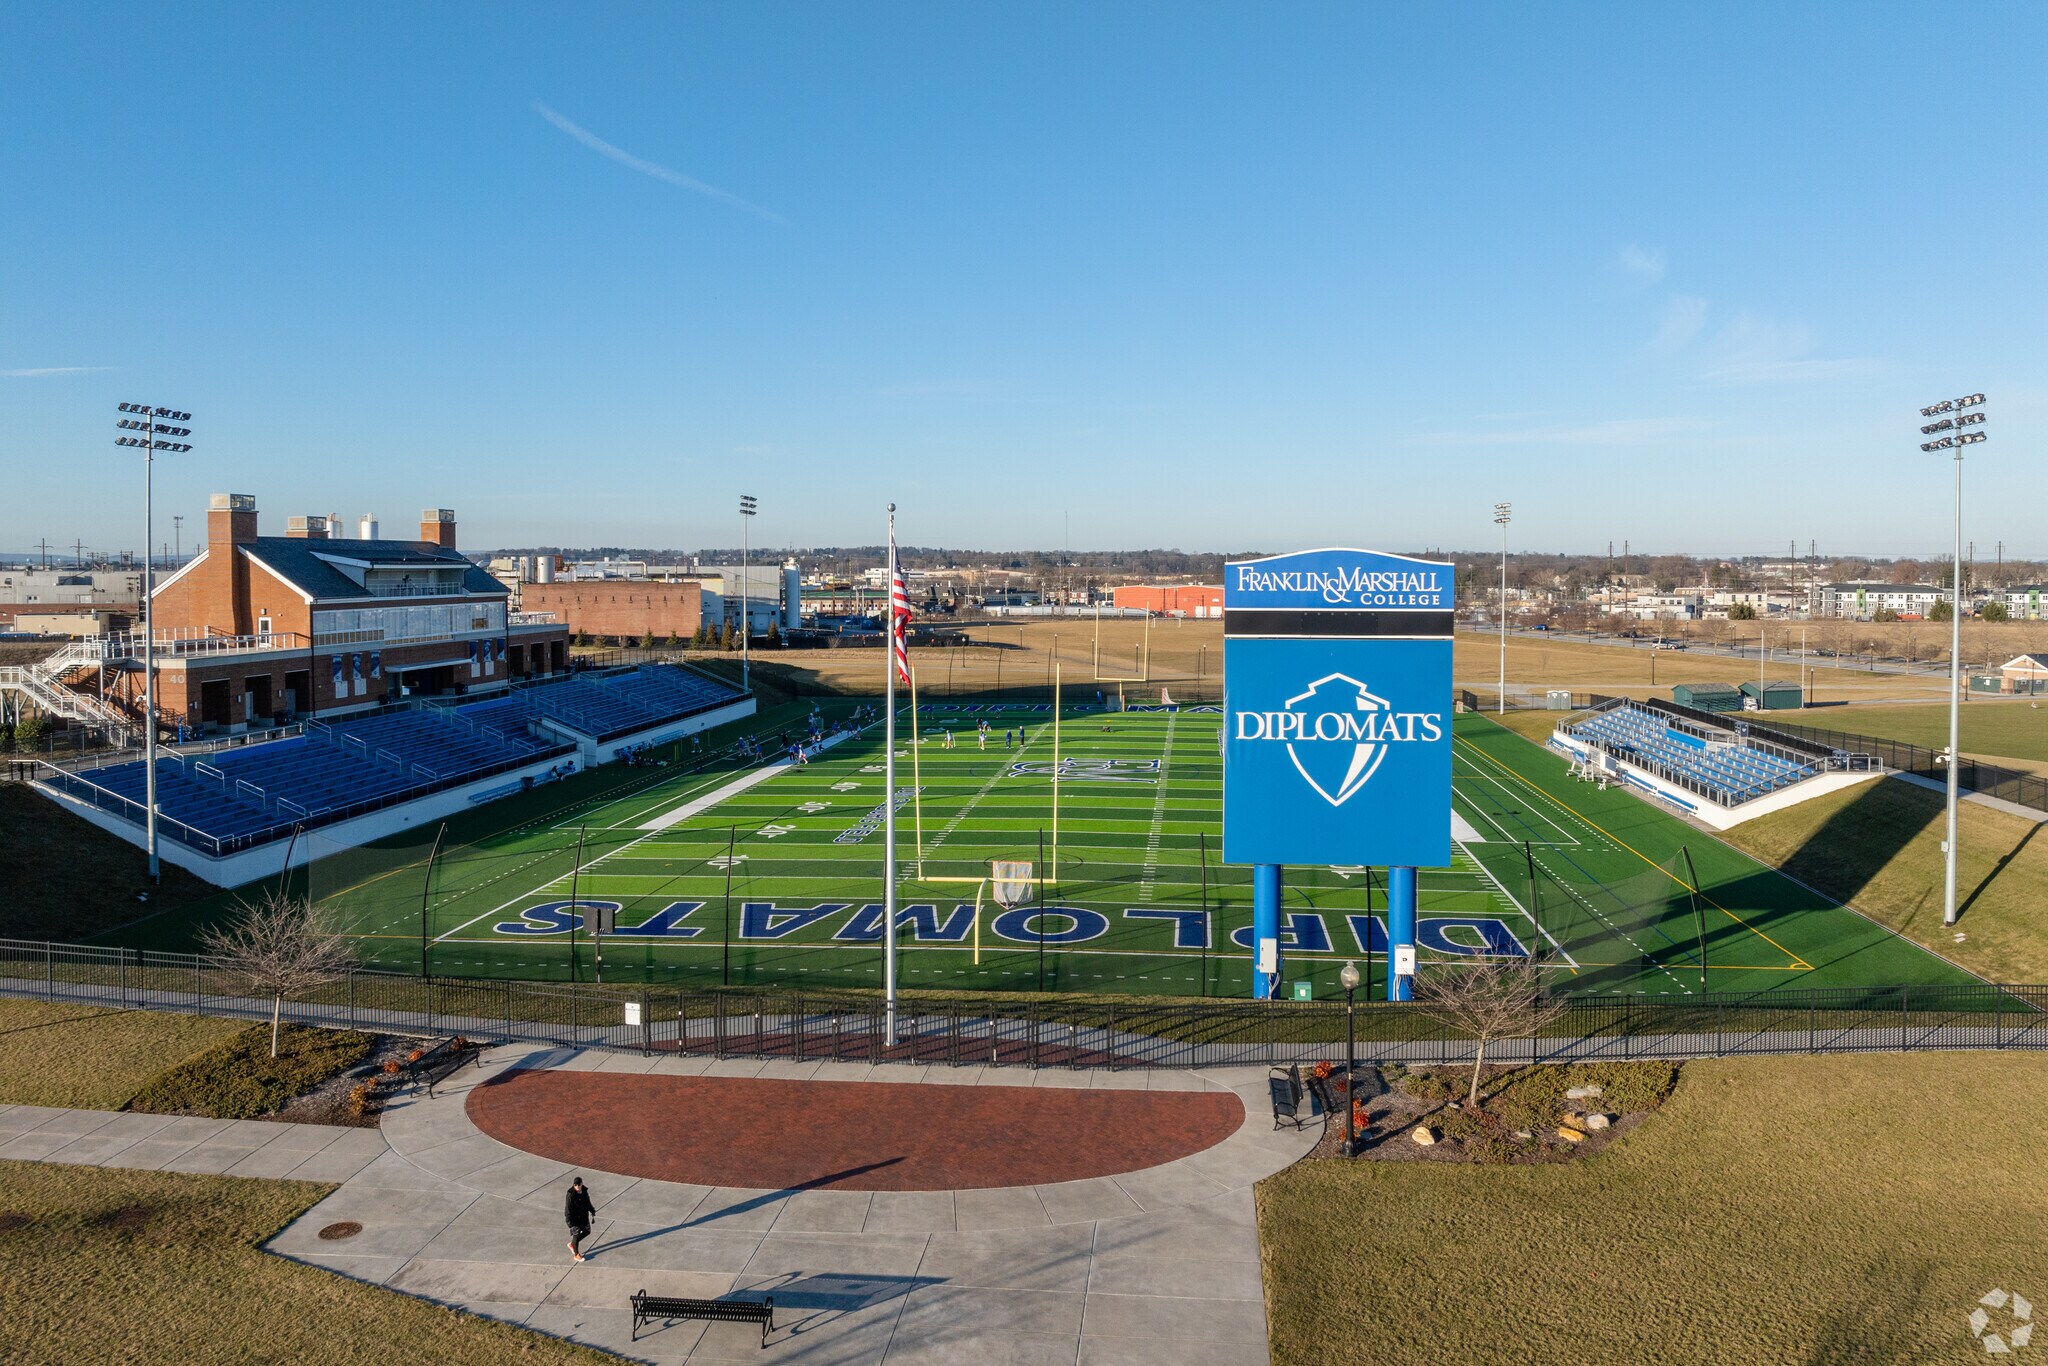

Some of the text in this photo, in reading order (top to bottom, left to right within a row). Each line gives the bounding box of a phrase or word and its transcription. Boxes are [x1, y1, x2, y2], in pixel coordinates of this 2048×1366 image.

[1237, 566, 1442, 603] FRANKLIN & MARSHALL
[1360, 593, 1440, 606] COLLEGE
[170, 674, 185, 684] 40
[1235, 711, 1442, 742] DIPLOMATS
[756, 824, 797, 835] 20
[493, 900, 1530, 957] DIPLOMATS
